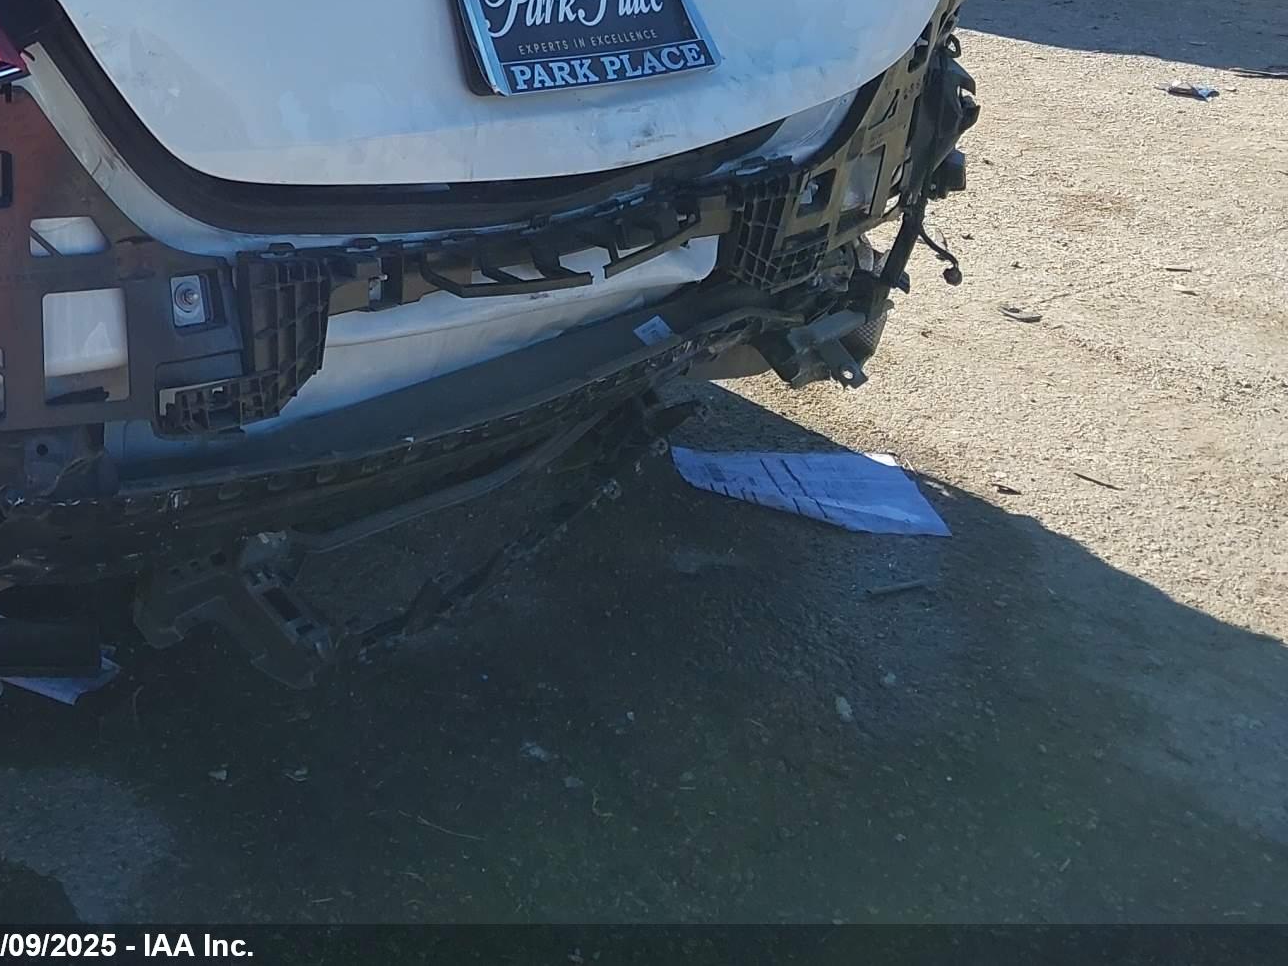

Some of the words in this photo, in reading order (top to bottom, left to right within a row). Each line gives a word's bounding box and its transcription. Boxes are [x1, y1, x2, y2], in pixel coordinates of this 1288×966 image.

[519, 39, 569, 56] EXPERTS
[574, 37, 586, 48] IN
[591, 29, 658, 47] EXCELLENCE
[510, 58, 599, 90] PARK
[601, 43, 705, 79] PLACE
